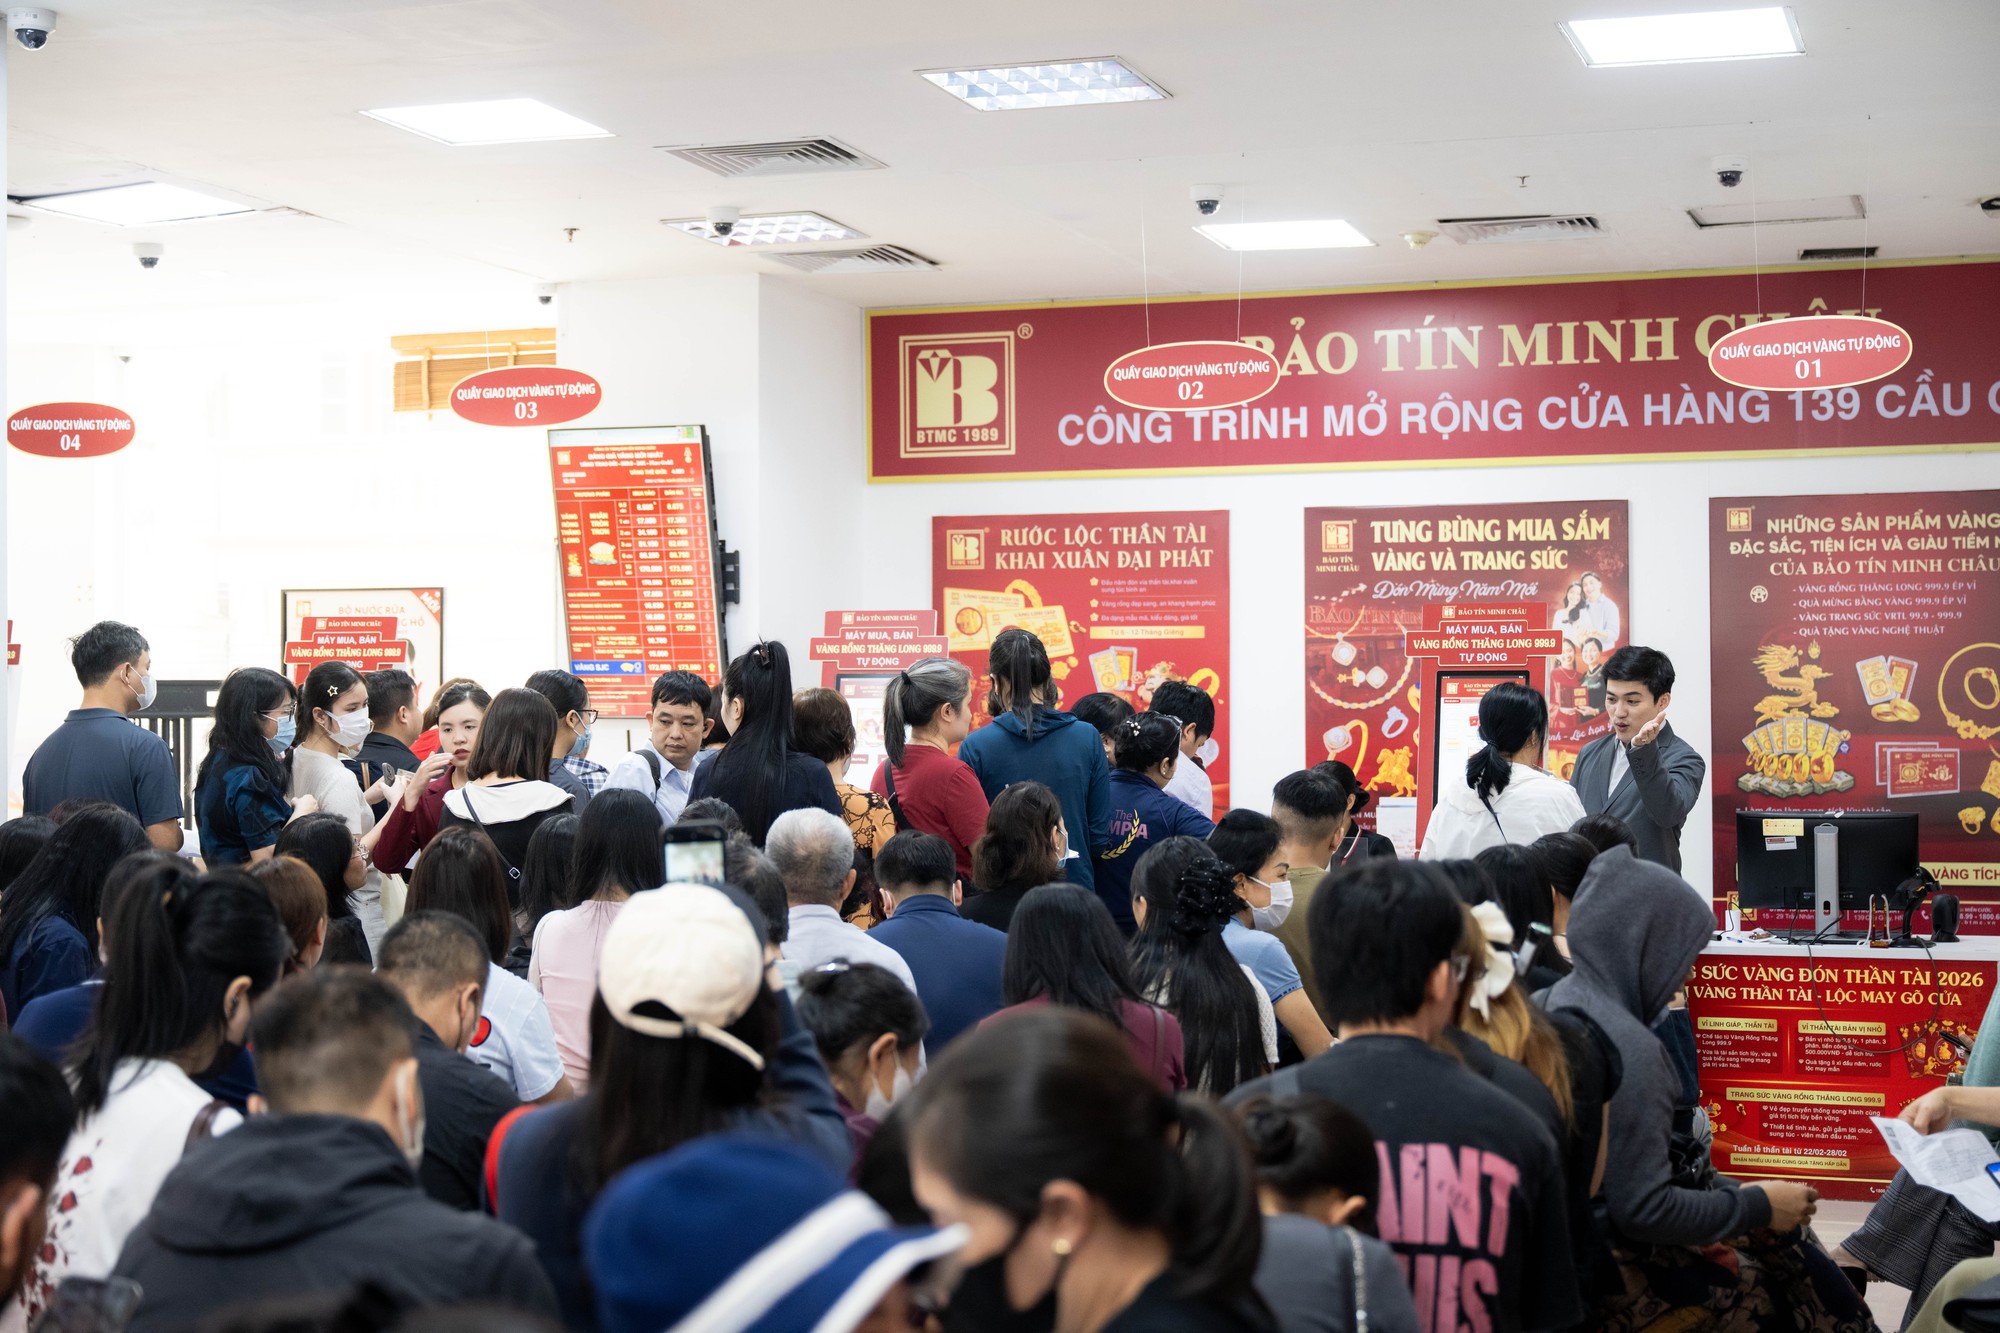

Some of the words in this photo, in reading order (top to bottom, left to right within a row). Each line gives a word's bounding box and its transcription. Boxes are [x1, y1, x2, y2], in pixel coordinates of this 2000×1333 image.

[1373, 314, 1483, 371] TÍN
[1497, 316, 1680, 367] MINH
[1719, 342, 1751, 360] QUẦY
[1752, 343, 1782, 356] GIAO
[1783, 341, 1811, 357] DỊCH
[1812, 338, 1846, 352] VÀNG
[1846, 336, 1864, 353] TỰ
[1864, 335, 1900, 351] ĐỘNG
[1113, 364, 1141, 381] QUẦY
[1142, 367, 1167, 378] GIAO
[1169, 365, 1192, 380] DỊCH
[1194, 362, 1222, 376] VÀNG
[1223, 363, 1237, 377] TỰ
[1239, 360, 1269, 376] ĐỘNG
[1795, 358, 1821, 379] 01
[457, 386, 483, 401] QUẦY
[483, 388, 505, 399] GIAO
[506, 387, 530, 400] DỊCH
[530, 384, 554, 397] VÀNG
[554, 383, 568, 398] TỰ
[568, 382, 595, 397] ĐỘNG
[1178, 381, 1204, 400] 02
[514, 401, 538, 419] 03
[1057, 405, 1172, 446] CÔNG
[1185, 402, 1308, 442] TRÌNH
[1323, 390, 1388, 437] MỞ
[1400, 392, 1523, 440] RỘNG
[1537, 383, 1629, 428] CỬA
[1643, 383, 1770, 425] HÀNG
[1787, 387, 1861, 421] 139
[1875, 368, 1971, 419] CẦU
[10, 417, 33, 431] QUẦY
[33, 420, 53, 430] GIAO
[53, 419, 73, 433] DỊCH
[73, 418, 95, 430] VÀNG
[95, 419, 107, 432] TỰ
[107, 418, 131, 432] ĐỘNG
[60, 434, 81, 451] 04
[916, 429, 956, 443] BTMC
[962, 427, 998, 441] 1989
[1507, 518, 1557, 541] MUA
[1562, 509, 1610, 540] SẮM
[1767, 513, 1835, 534] NHỮNG
[1841, 512, 1879, 531] SẢN
[1885, 508, 1941, 530] PHẨM
[1946, 511, 2000, 528] VÀNG
[1001, 526, 1056, 546] RƯỚC
[1064, 525, 1101, 547] LỘC
[1108, 524, 1165, 544] THẦN
[1172, 523, 1206, 543] TÀI
[1729, 539, 1764, 557] ĐẶC
[1769, 538, 1806, 554] SẮC,
[1810, 537, 1844, 555] TIỆN
[1849, 537, 1876, 551] ÍCH
[1881, 536, 1902, 550] VÀ
[1907, 535, 1947, 550] GIÀU
[1952, 534, 1989, 549] TIỀM
[995, 551, 1044, 569] KHAI
[1052, 549, 1109, 568] XUÂN
[1117, 550, 1151, 570] ĐẠI
[1159, 548, 1213, 567] PHÁT
[1371, 549, 1425, 571] VÀNG
[1429, 547, 1456, 570] VÀ
[1460, 550, 1525, 570] TRANG
[1530, 546, 1568, 569] SỨC
[1769, 558, 1807, 575] CỦA
[1812, 557, 1851, 574] BẢO
[1855, 557, 1886, 573] TÍN
[1892, 559, 1941, 572] MINH
[1947, 554, 2000, 572] CHÂU
[1372, 581, 1410, 599] Đón
[1410, 580, 1459, 602] Mừng
[1460, 581, 1501, 598] Năm
[1501, 580, 1538, 597] Mới
[1799, 584, 1826, 593] VÀNG
[1829, 581, 1856, 592] RỒNG
[1859, 582, 1893, 592] THĂNG
[1896, 583, 1922, 591] LONG
[1952, 581, 1964, 590] ÉP
[1967, 580, 1977, 590] VỈ
[1458, 608, 1473, 616] BẢO
[1474, 607, 1486, 615] TÍN
[1507, 607, 1527, 615] CHÂU
[845, 630, 866, 639] MÁY
[867, 631, 891, 640] MUA,
[893, 630, 913, 639] BÁN
[1446, 624, 1468, 634] MÁY
[1471, 625, 1497, 634] MUA,
[1499, 623, 1522, 633] BÁN
[1798, 626, 1820, 637] QUÀ
[1822, 626, 1849, 636] TẶNG
[1851, 626, 1879, 634] VÀNG
[1882, 625, 1910, 635] NGHỆ
[1914, 625, 1944, 634] THUẬT
[317, 635, 335, 644] MÁY
[336, 636, 357, 644] MUA,
[358, 635, 377, 644] BÁN
[816, 643, 840, 653] VÀNG
[841, 642, 866, 653] RỒNG
[867, 642, 896, 653] THĂNG
[898, 644, 921, 653] LONG
[922, 643, 942, 653] 999.9
[1413, 638, 1440, 649] VÀNG
[1441, 637, 1469, 648] RỒNG
[1470, 637, 1504, 648] THĂNG
[1506, 638, 1532, 648] LONG
[1534, 638, 1556, 648] 999.9
[290, 646, 312, 657] VÀNG
[312, 645, 334, 657] RỒNG
[335, 646, 362, 656] THĂNG
[362, 648, 383, 656] LONG
[383, 647, 401, 656] 999.9
[1459, 652, 1474, 663] TỰ
[1476, 652, 1507, 662] ĐỘNG
[856, 657, 870, 667] TỰ
[871, 657, 899, 666] ĐỘNG
[1115, 809, 1133, 821] The
[1932, 866, 1969, 880] VÀNG
[1973, 866, 2000, 880] TÍCH
[1701, 963, 1737, 980] SỨC
[1742, 964, 1793, 981] VÀNG
[1798, 965, 1838, 982] ĐÓN
[1843, 966, 1895, 984] THẦN
[1900, 967, 1930, 985] TÀI
[1937, 971, 1984, 987] 2026
[1695, 984, 1736, 999] VÀNG
[1739, 985, 1782, 1000] THẦN
[1786, 986, 1812, 1001] TÀI
[1826, 986, 1857, 1002] LỘC
[1861, 990, 1896, 1003] MAY
[1900, 989, 1924, 1004] GÕ
[1927, 988, 1961, 1004] CỬA
[1733, 1145, 1752, 1153] Tuần
[1753, 1145, 1761, 1153] lễ
[1763, 1145, 1780, 1154] thần
[1781, 1146, 1792, 1154] tài
[1803, 1148, 1848, 1157] 22/02-28/02
